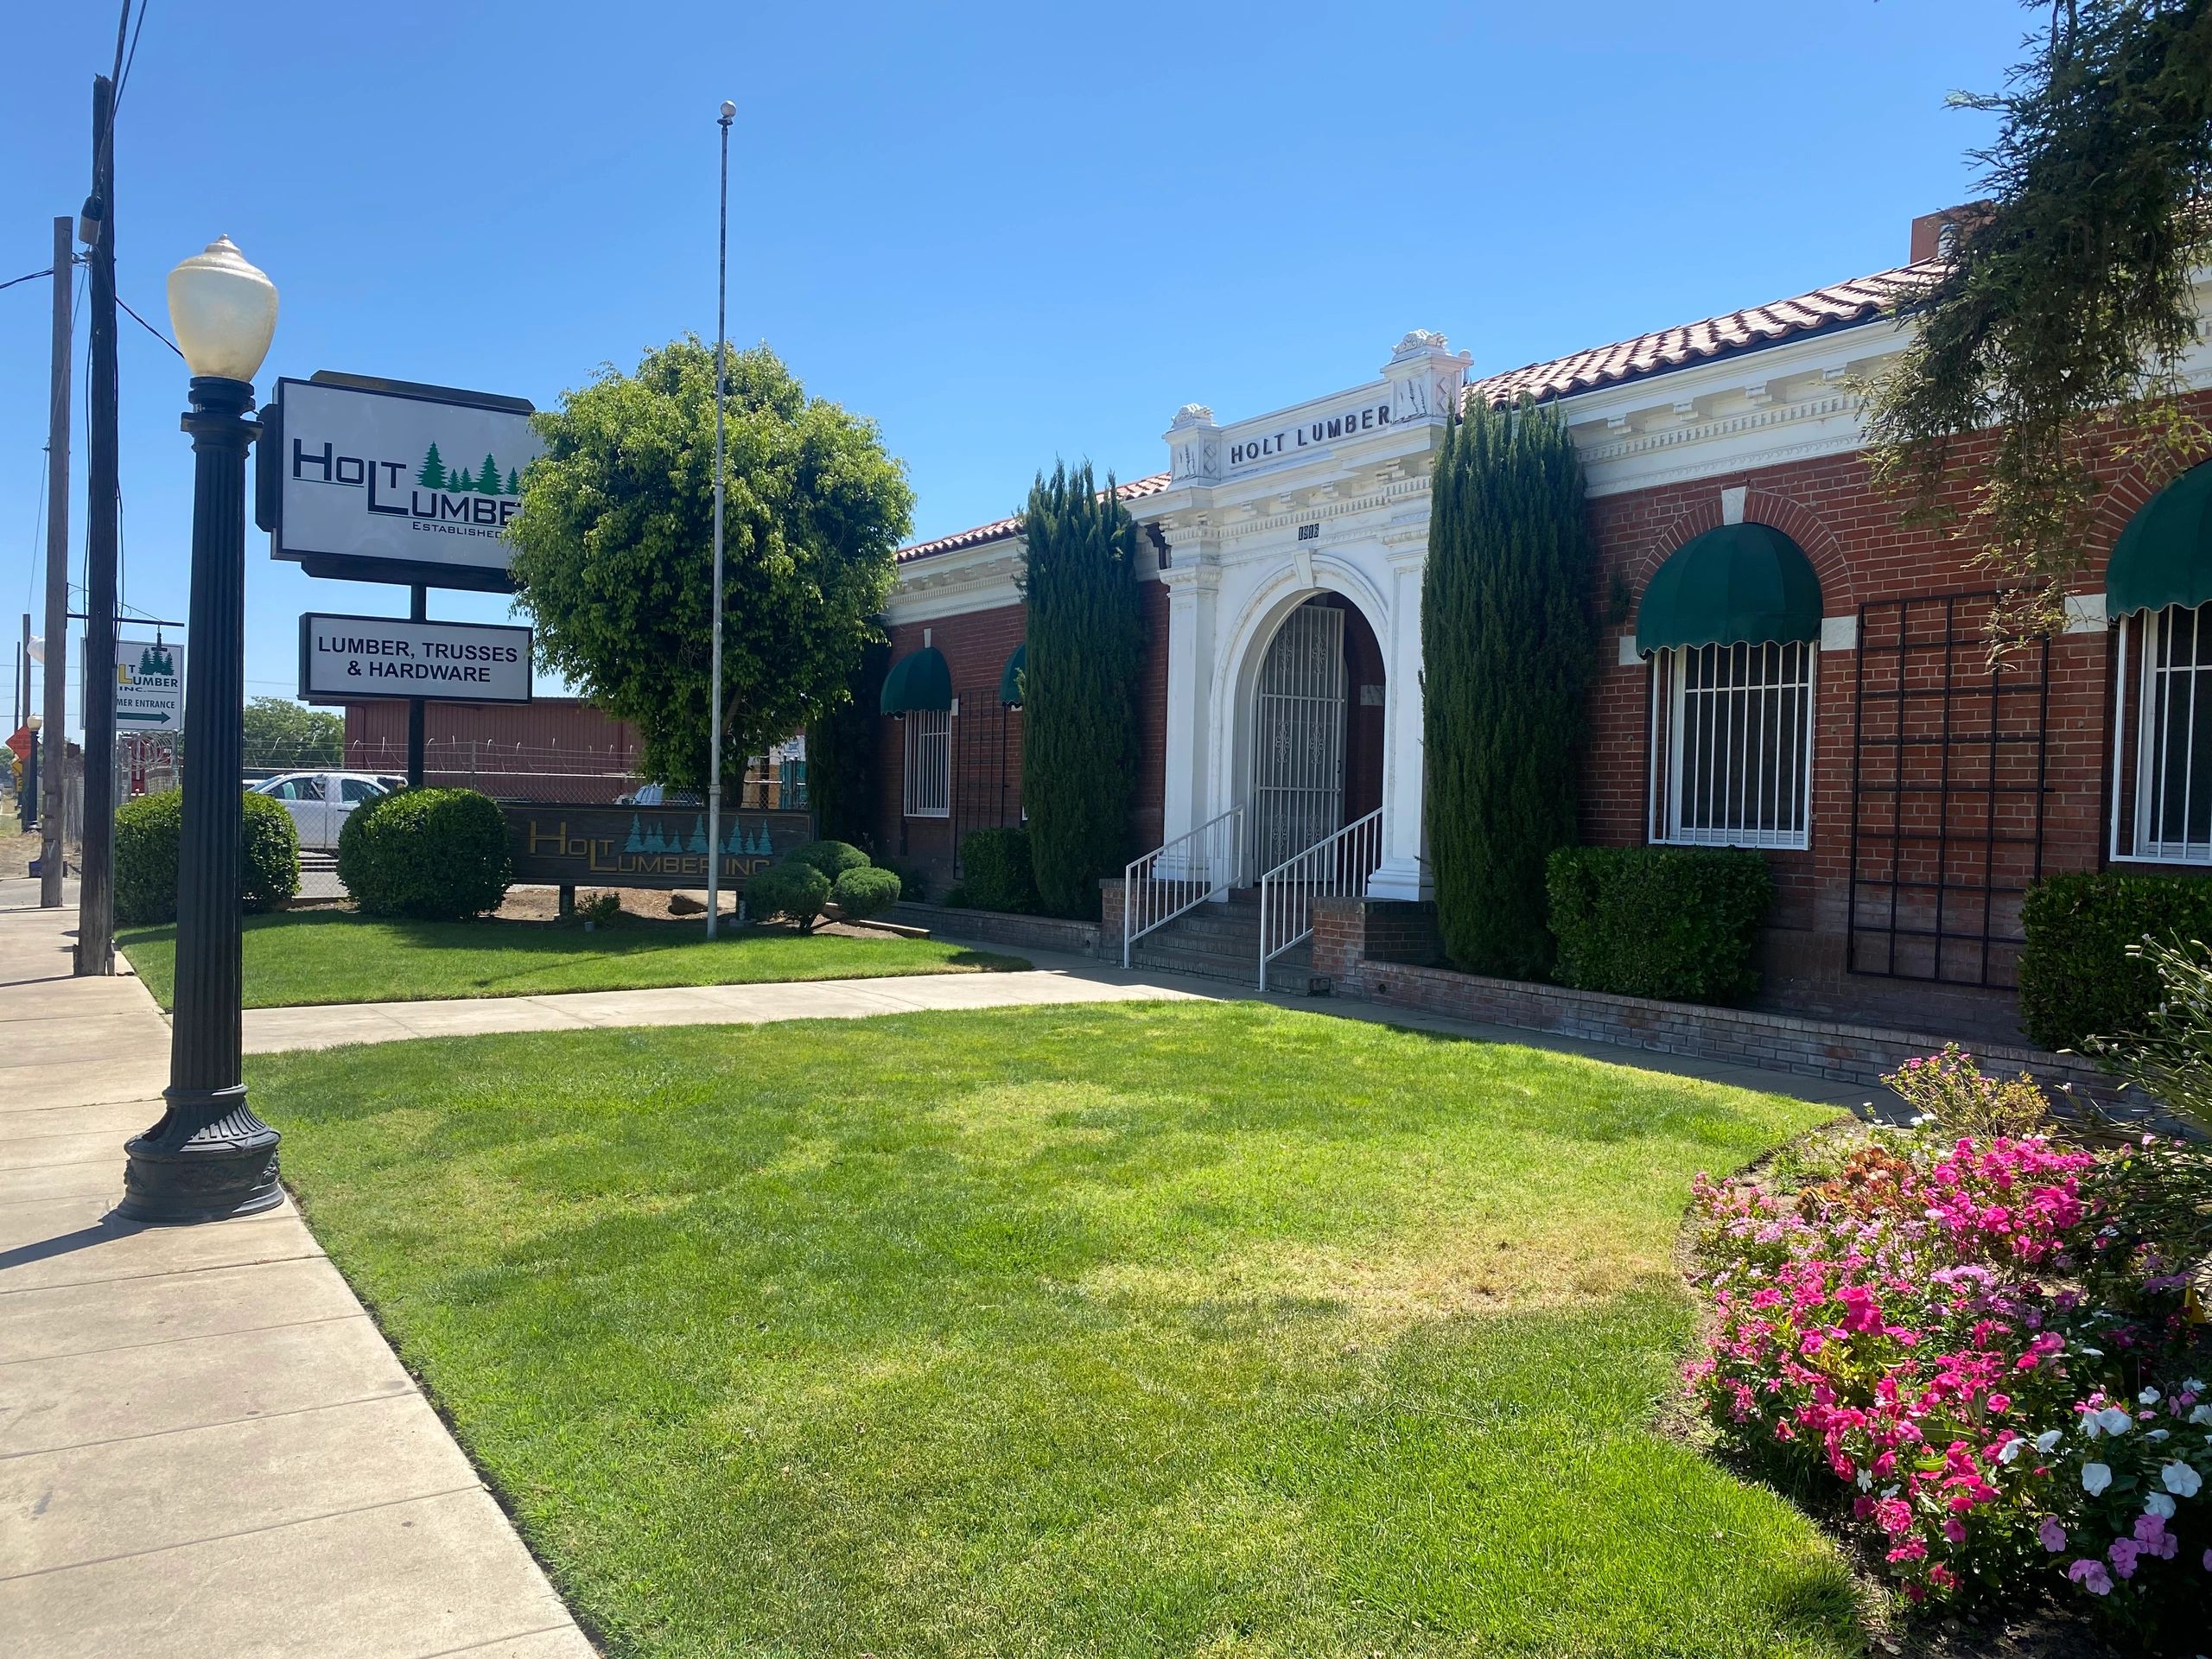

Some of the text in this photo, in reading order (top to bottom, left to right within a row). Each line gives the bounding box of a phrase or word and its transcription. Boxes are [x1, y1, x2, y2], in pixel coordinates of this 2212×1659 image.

[1231, 405, 1389, 464] HOLT LUMBER
[367, 461, 521, 526] LUMBE
[318, 636, 518, 663] LUMBER, TRUSSES
[346, 661, 491, 683] & HARDWARE
[135, 699, 175, 709] ENTRANCE
